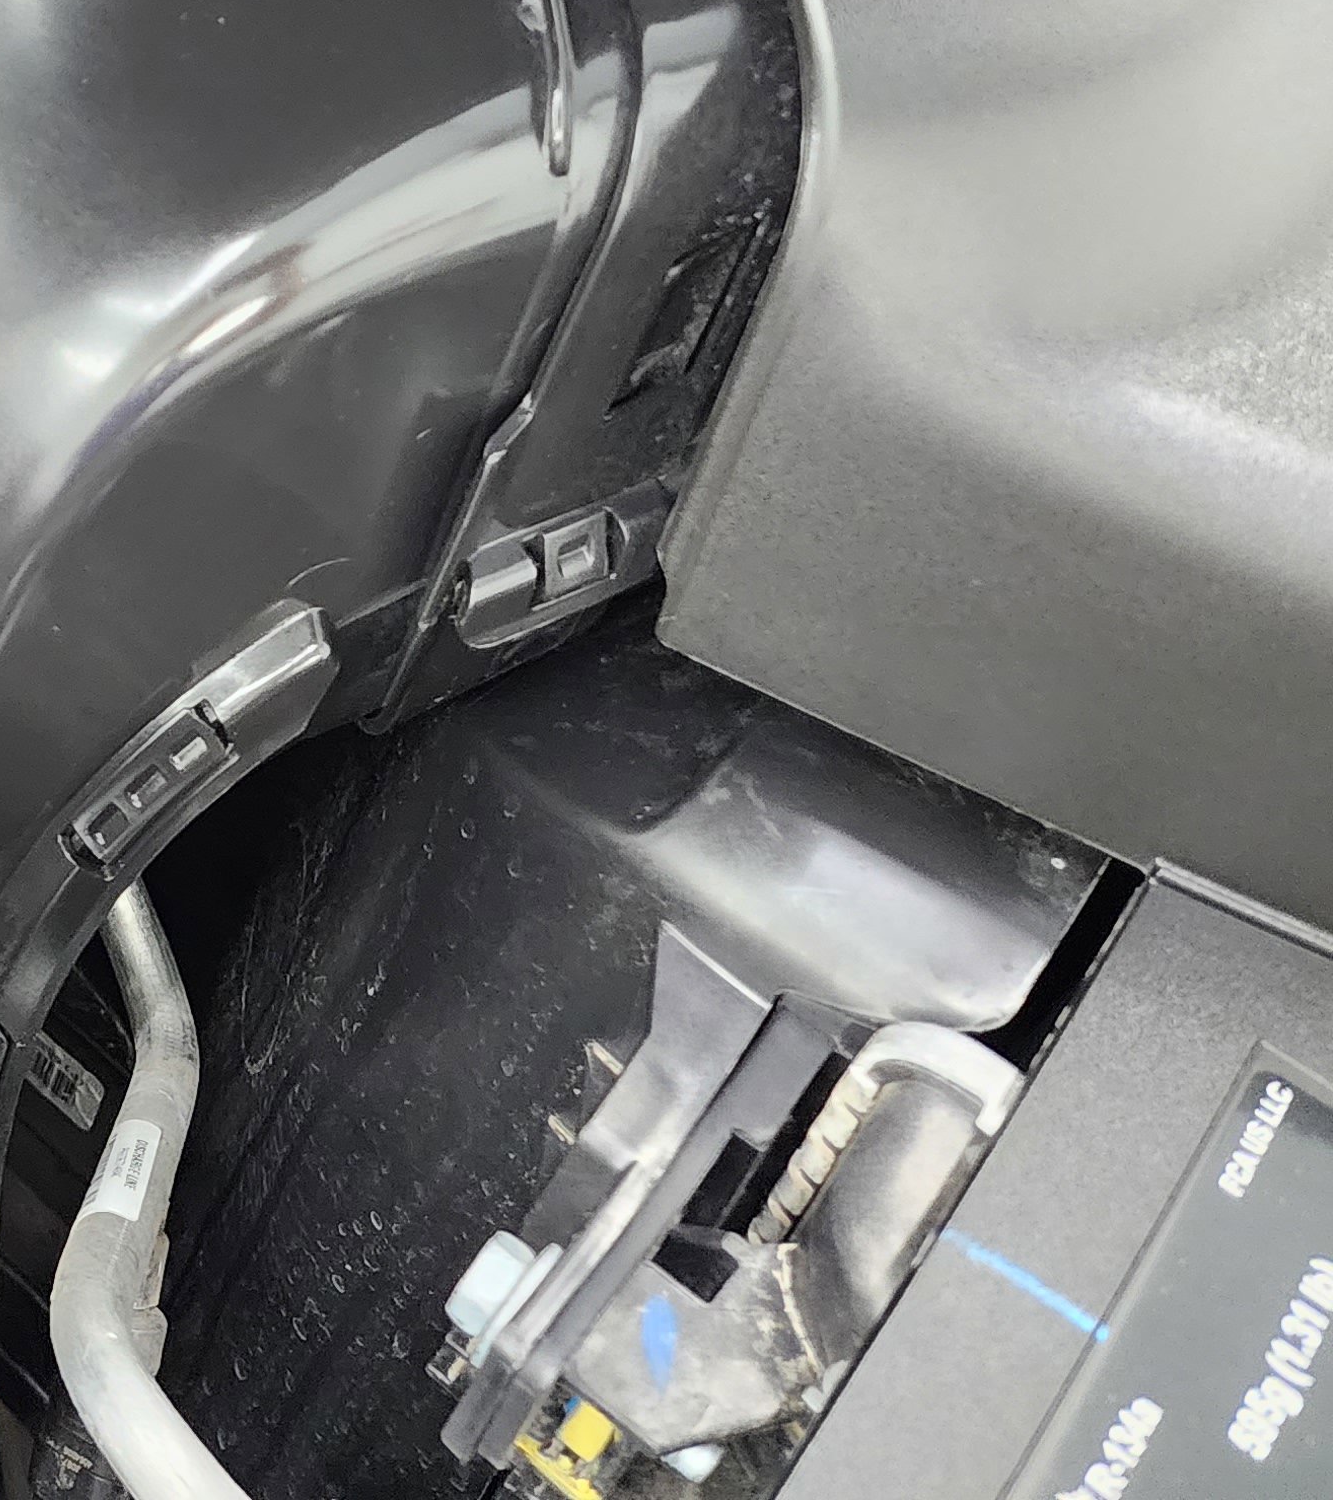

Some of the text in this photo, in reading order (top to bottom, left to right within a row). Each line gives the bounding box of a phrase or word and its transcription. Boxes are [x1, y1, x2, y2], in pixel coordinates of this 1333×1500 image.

[1218, 1079, 1295, 1198] FCA US LLC
